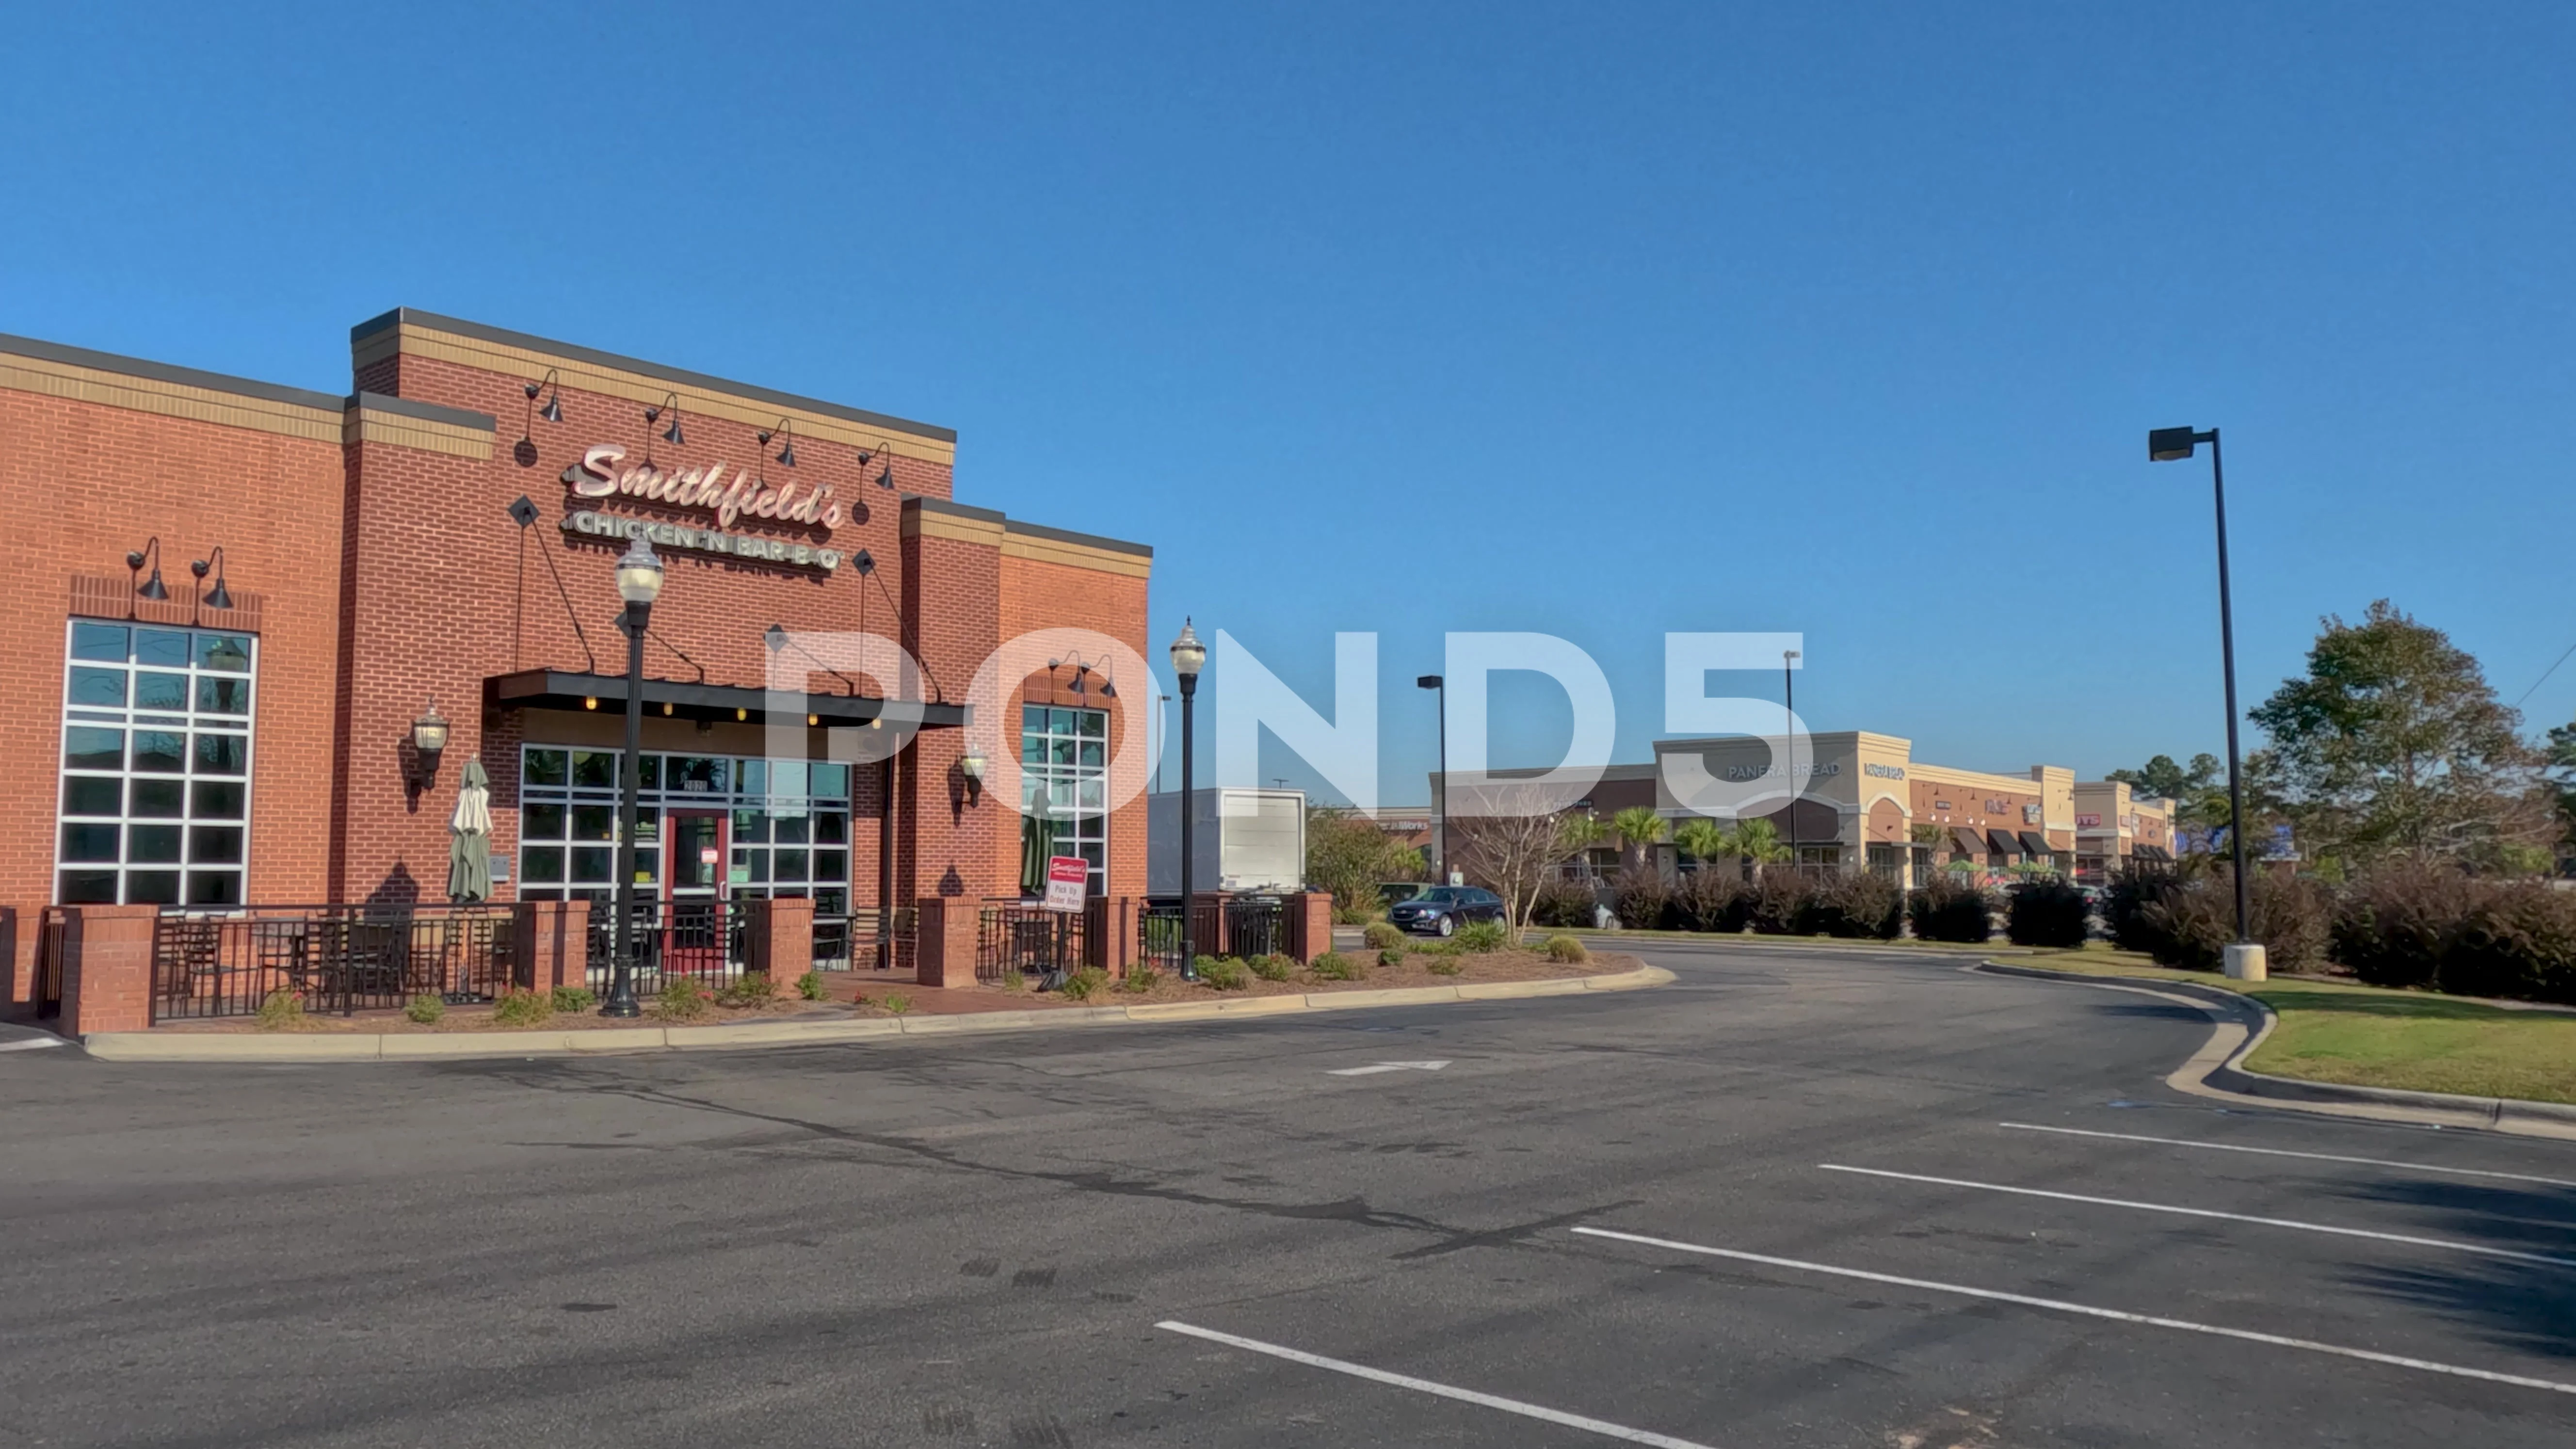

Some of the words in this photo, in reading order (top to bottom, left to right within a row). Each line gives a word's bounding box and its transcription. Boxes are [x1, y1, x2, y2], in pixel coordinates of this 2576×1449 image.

[573, 444, 845, 529] Smithfield's
[574, 511, 694, 548] CHICKEN
[1729, 764, 1787, 779] PANERA
[1793, 762, 1842, 777] BREAD
[1055, 885, 1066, 893] Pick
[1069, 886, 1077, 896] Up
[1049, 895, 1065, 904] Order
[1067, 897, 1079, 906] Here
